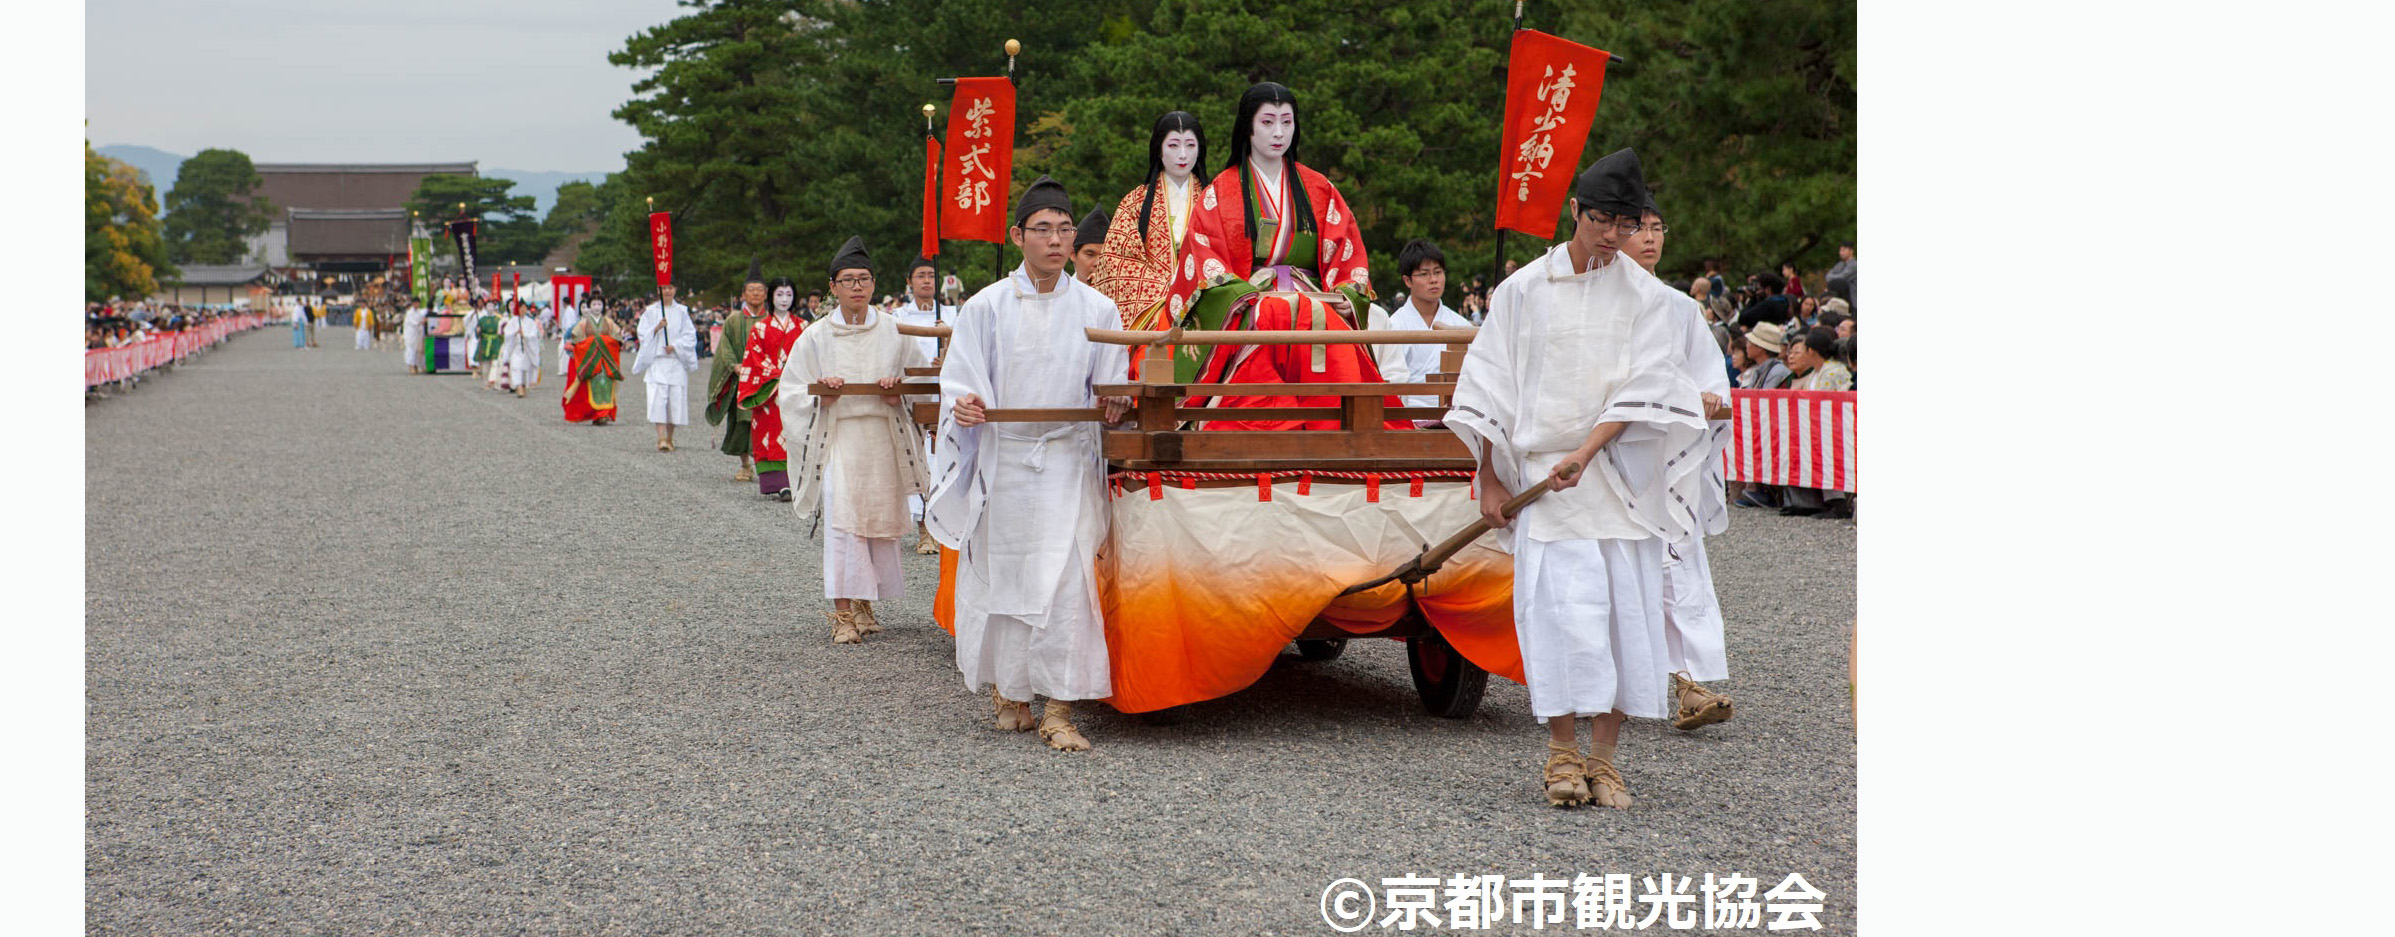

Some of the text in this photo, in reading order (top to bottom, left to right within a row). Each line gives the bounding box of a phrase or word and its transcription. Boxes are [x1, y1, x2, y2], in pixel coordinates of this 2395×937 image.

[954, 96, 996, 215] 紫式部
[1512, 62, 1577, 202] 清少納言
